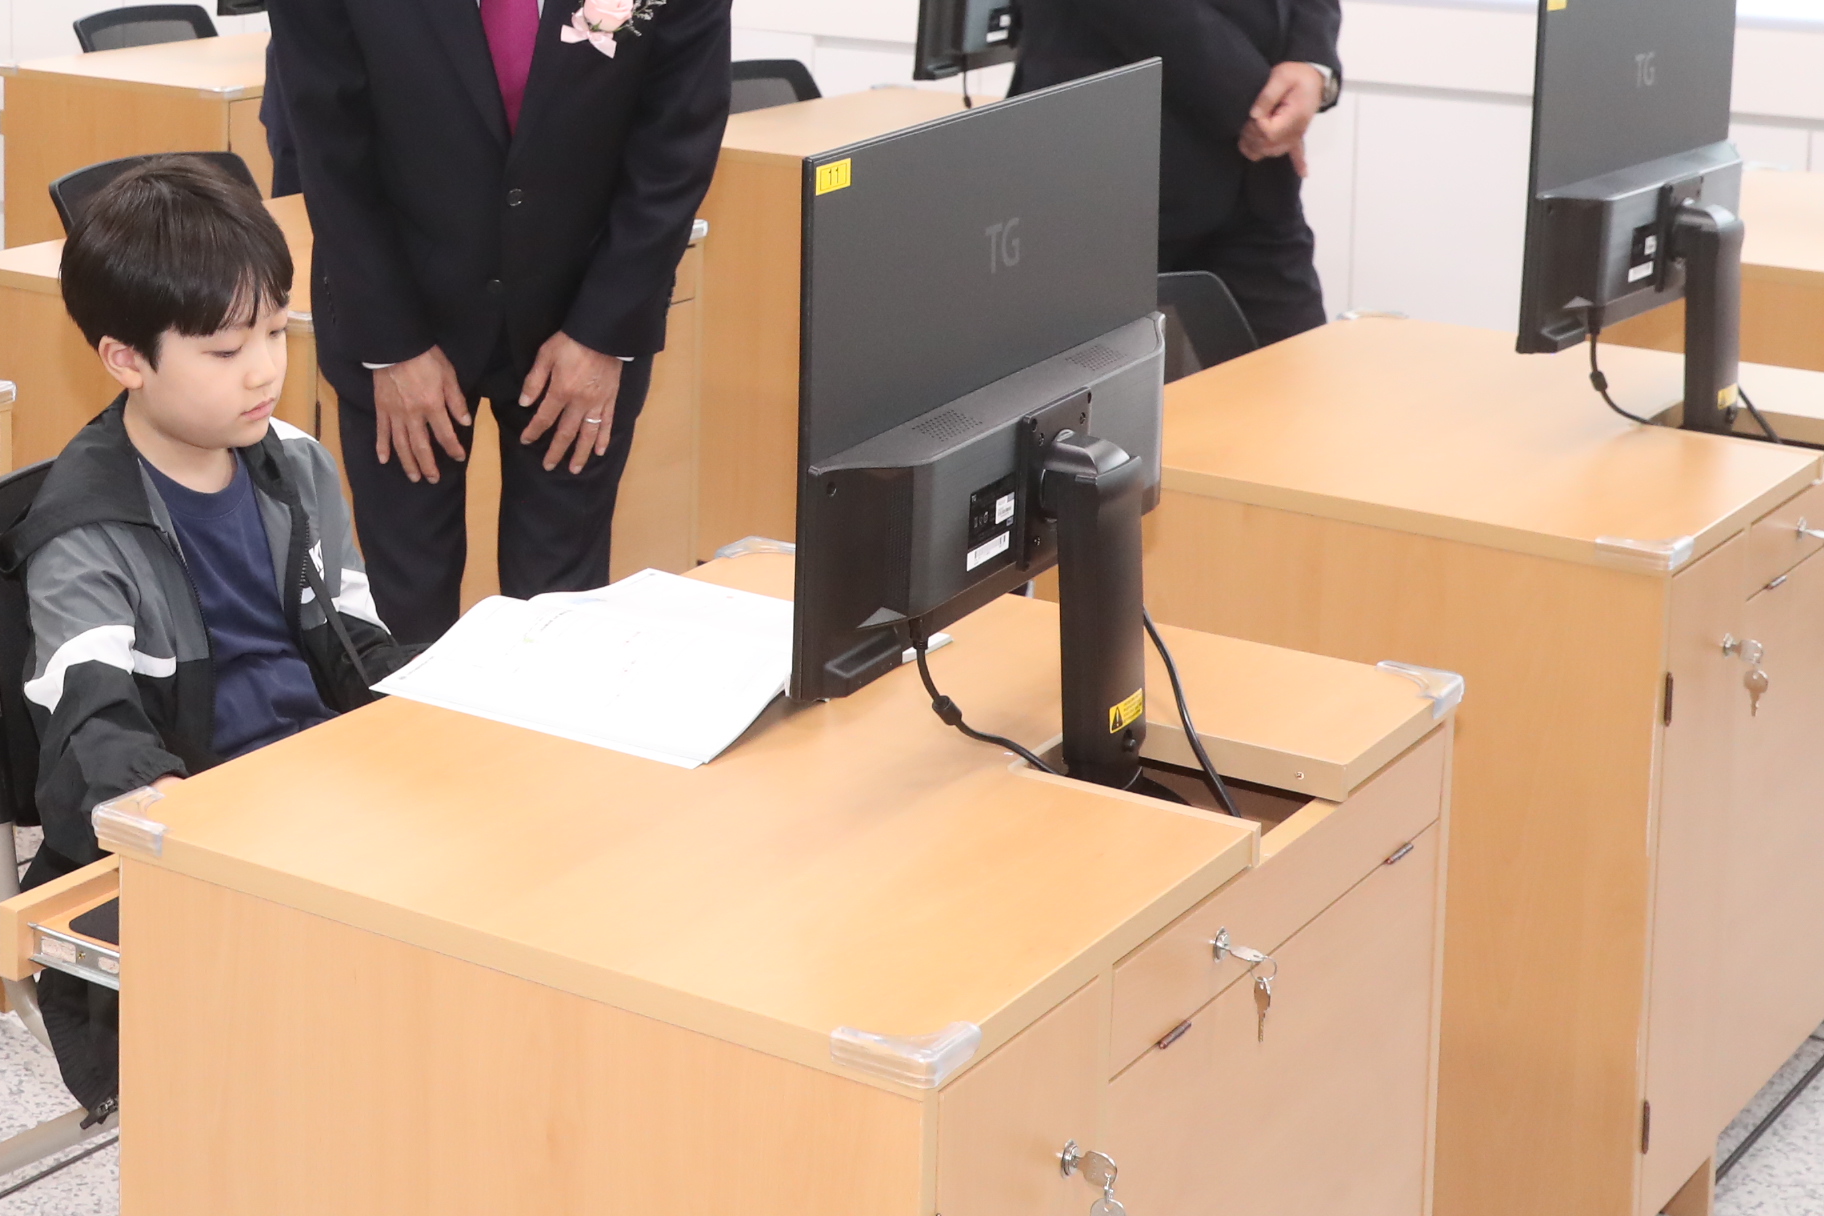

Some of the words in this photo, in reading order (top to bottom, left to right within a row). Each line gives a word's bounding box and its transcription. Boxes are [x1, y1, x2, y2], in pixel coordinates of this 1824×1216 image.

[1635, 52, 1655, 88] TG
[829, 166, 839, 186] 11
[985, 217, 1020, 274] TG
